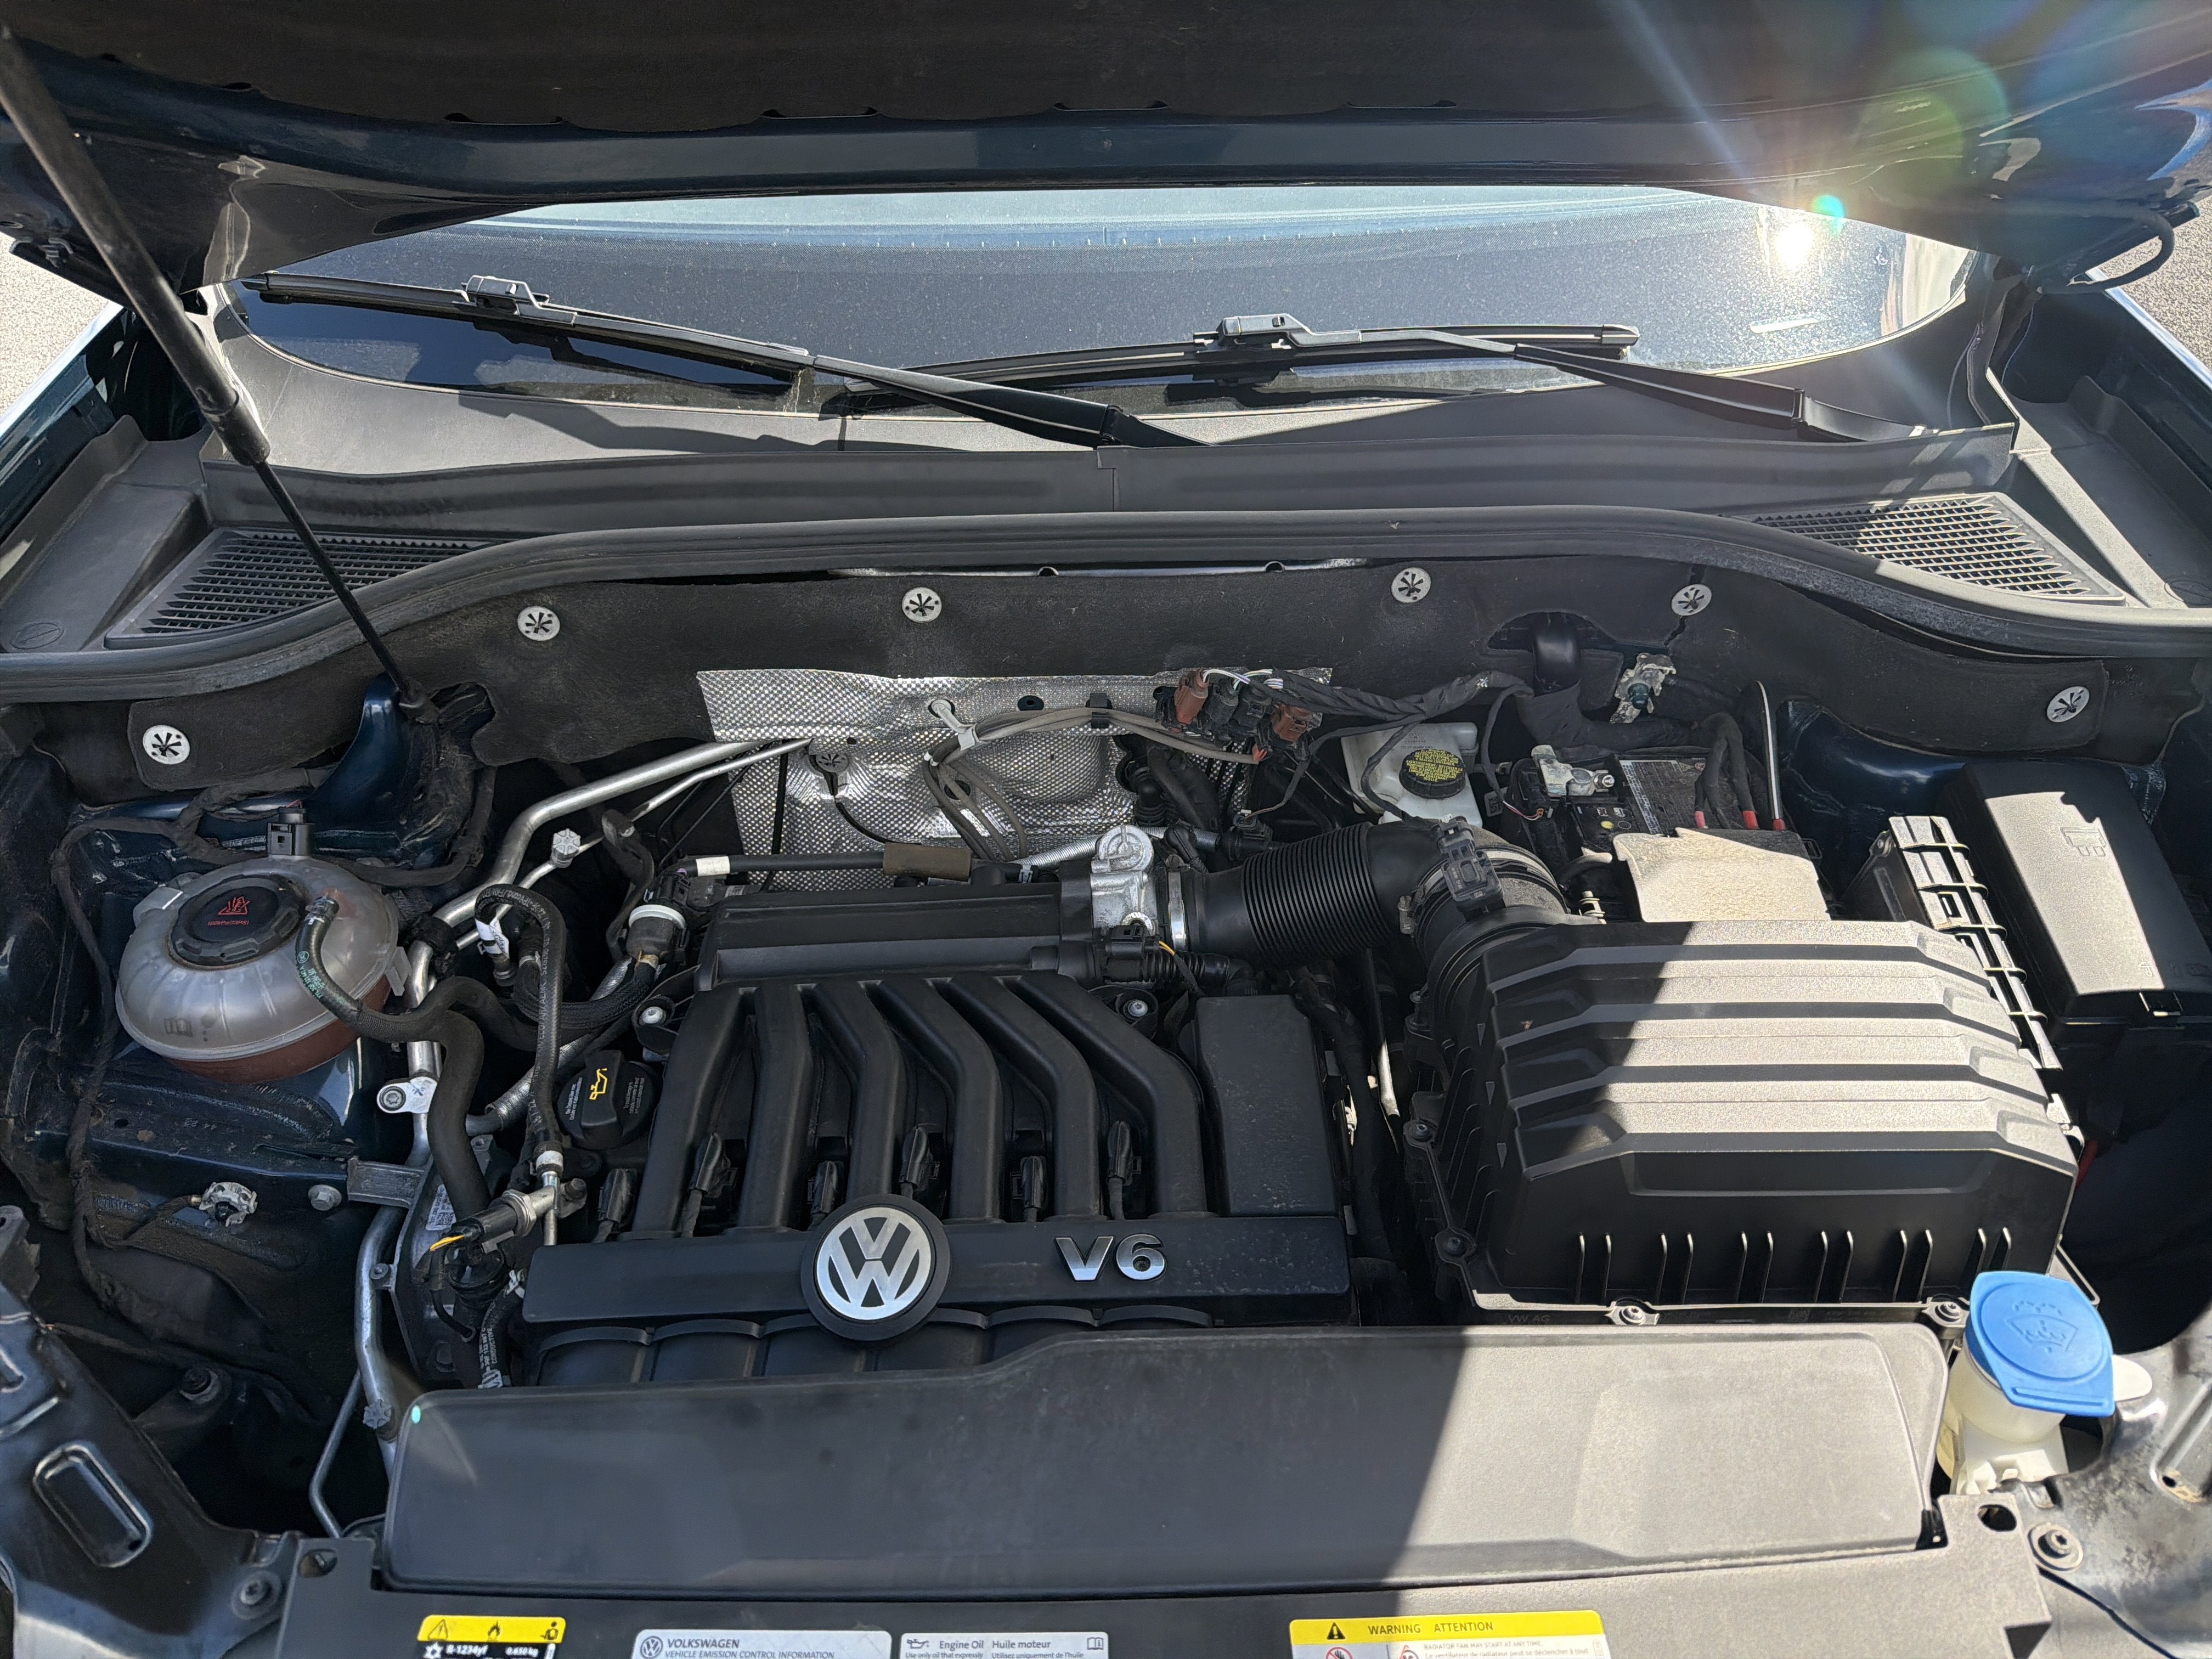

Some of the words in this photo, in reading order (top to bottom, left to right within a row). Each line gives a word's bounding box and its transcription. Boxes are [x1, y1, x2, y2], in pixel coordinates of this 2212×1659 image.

[1053, 1234, 1166, 1282] V6
[487, 1328, 498, 1364] CONDUCTIVE
[1368, 1624, 1421, 1635] WARNING
[1434, 1622, 1494, 1633] ATTENTION
[667, 1638, 740, 1649] VOLKSWAGEN
[939, 1640, 970, 1651] Engine
[971, 1640, 984, 1649] Oil
[992, 1640, 1016, 1649] Huile
[1018, 1640, 1051, 1648] moteur
